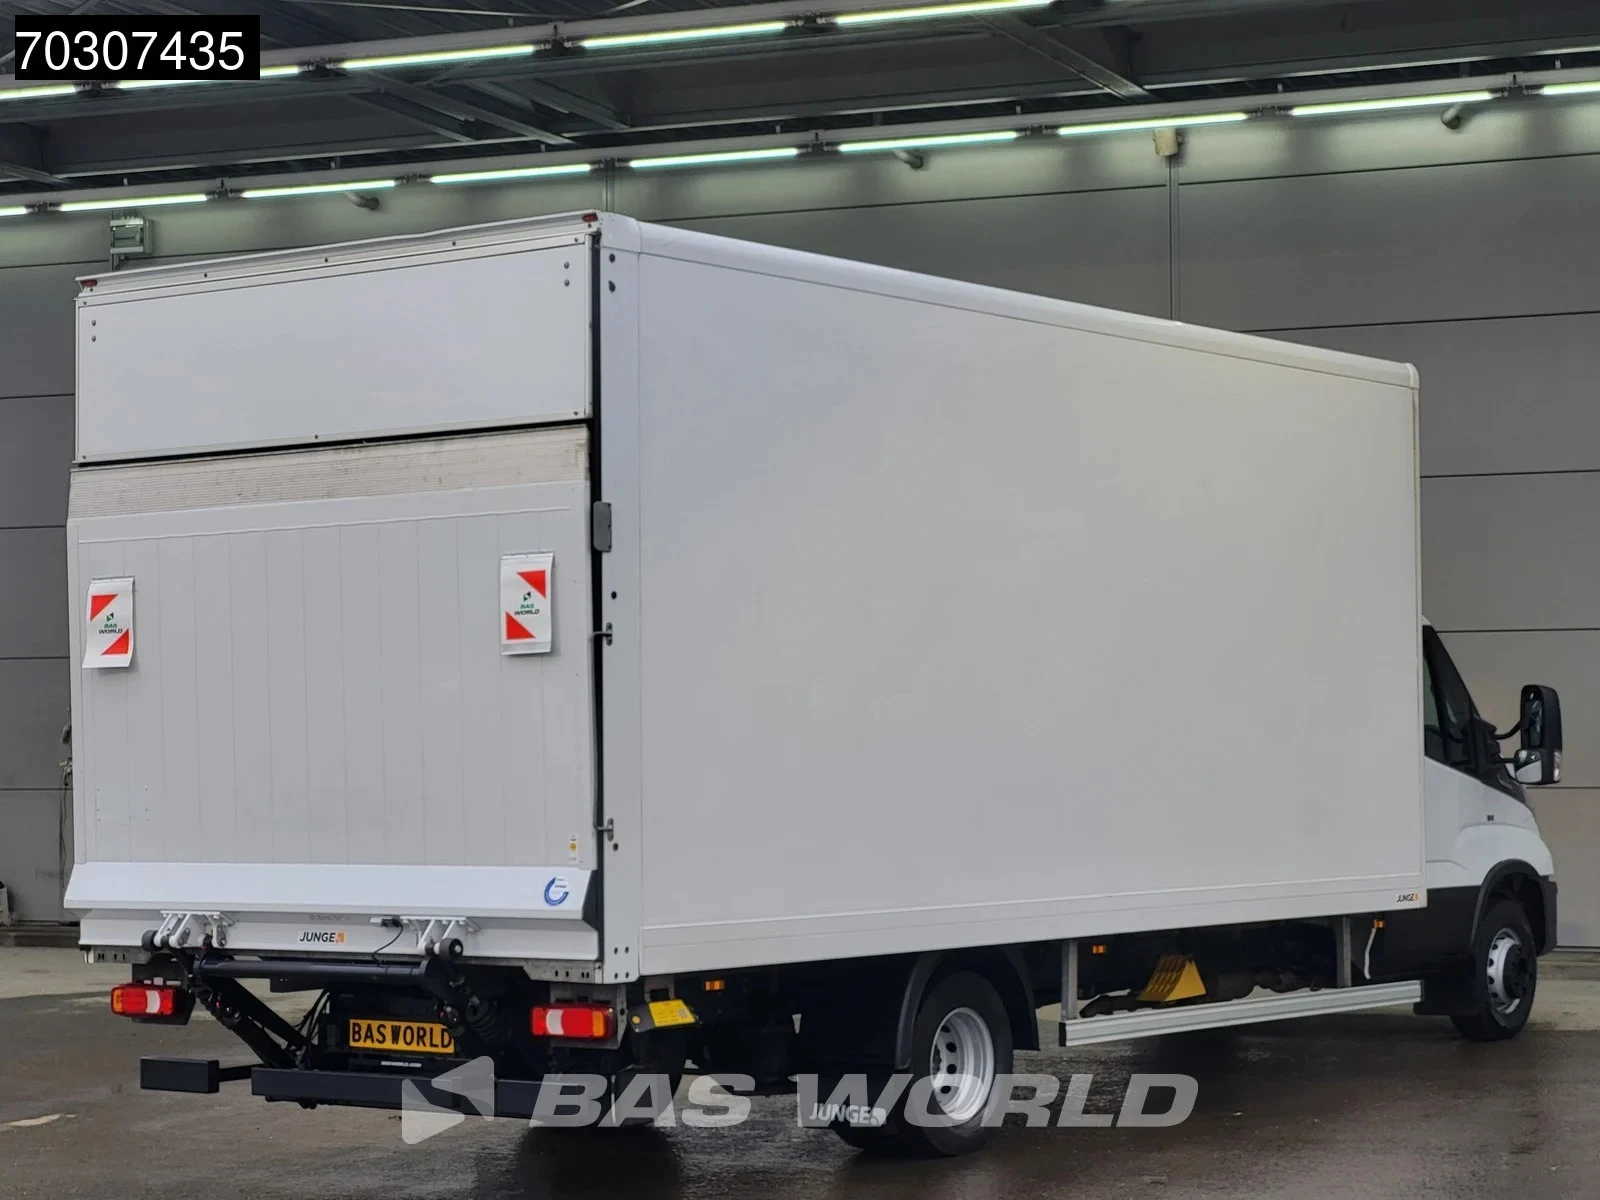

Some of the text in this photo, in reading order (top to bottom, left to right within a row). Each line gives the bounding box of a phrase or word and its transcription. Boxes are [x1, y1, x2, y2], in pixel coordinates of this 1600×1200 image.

[299, 931, 336, 943] JUNGE
[352, 1022, 453, 1049] BAS WORLD
[809, 1102, 871, 1125] JUNGE
